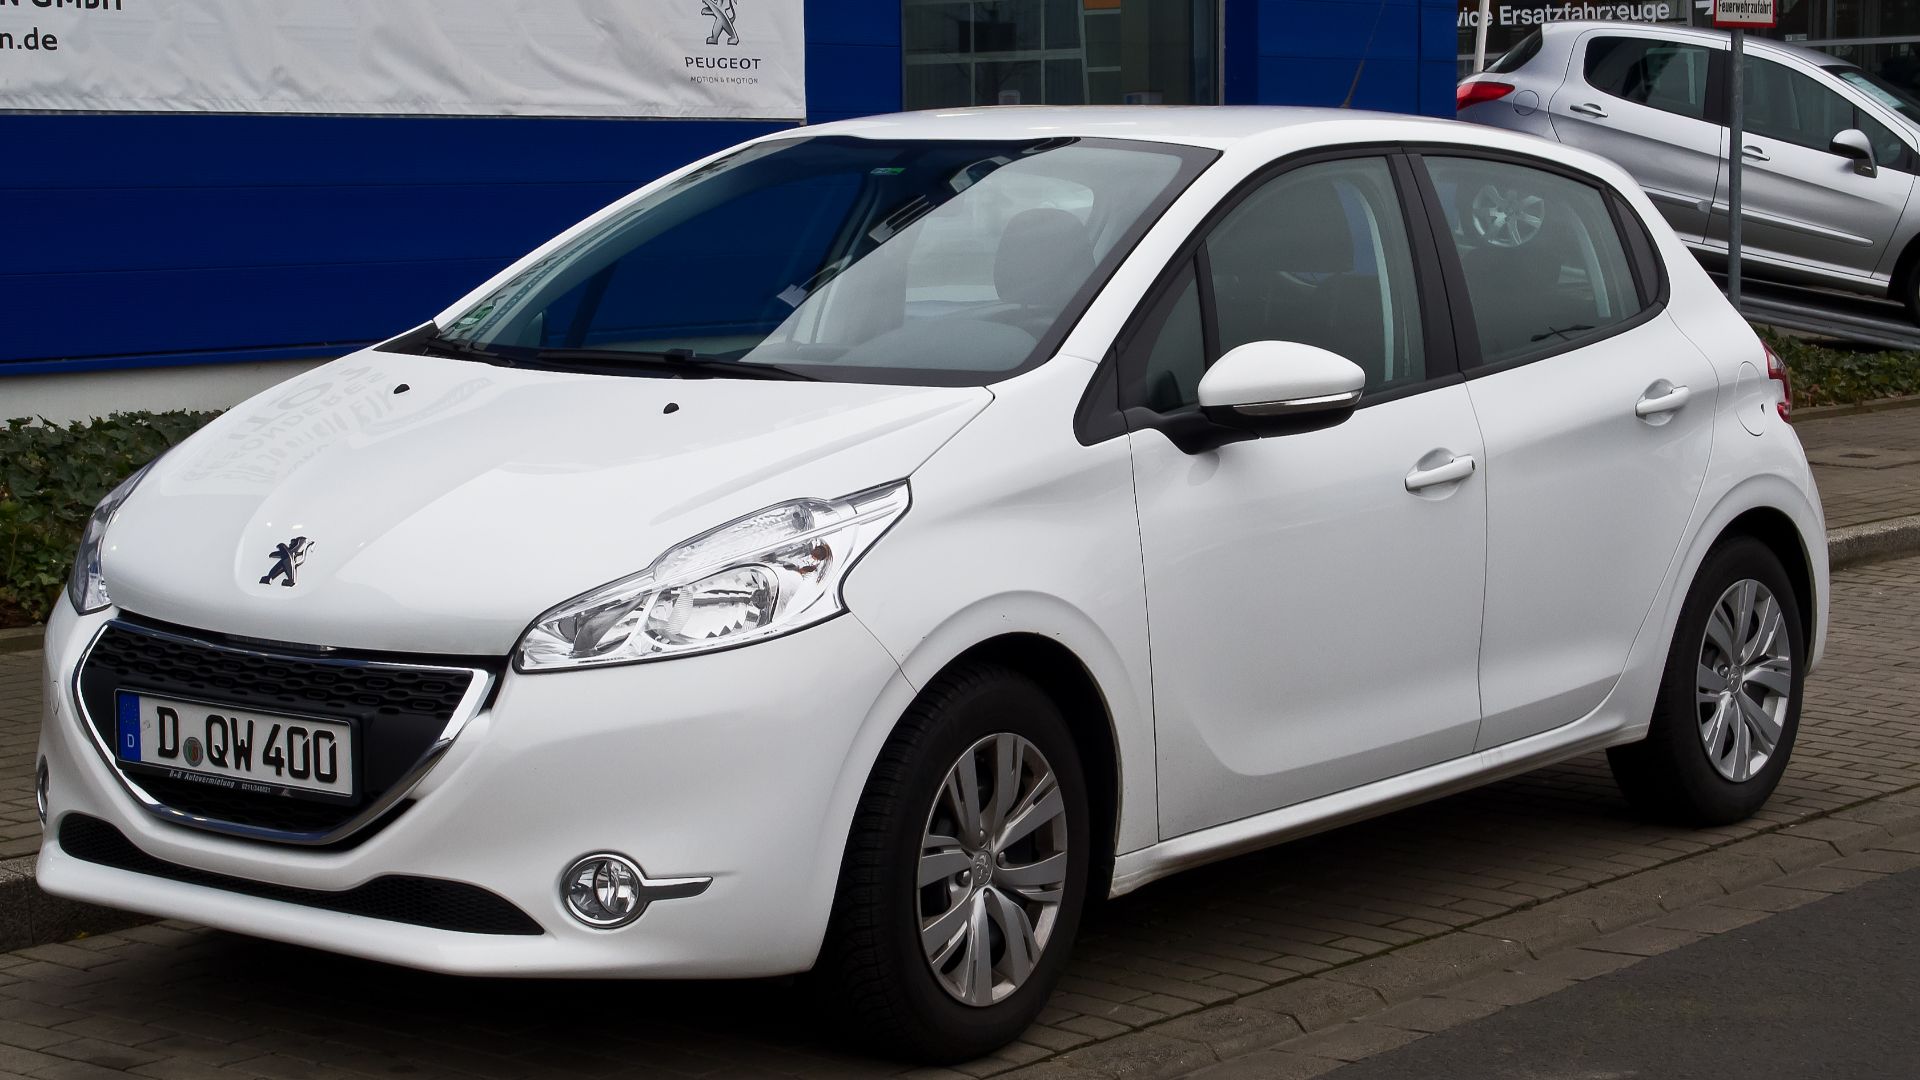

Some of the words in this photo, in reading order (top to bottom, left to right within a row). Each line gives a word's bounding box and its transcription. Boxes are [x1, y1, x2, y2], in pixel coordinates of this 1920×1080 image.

[1500, 2, 1670, 26] Ersatzfahrzeuge
[1718, 0, 1772, 15] Feuerwehrzufahrt
[685, 56, 761, 70] PEUGEOT
[690, 76, 718, 84] MOTION
[726, 77, 758, 85] EMOTION
[157, 706, 179, 758] D
[127, 734, 134, 748] D
[184, 773, 235, 788] Autovermietung
